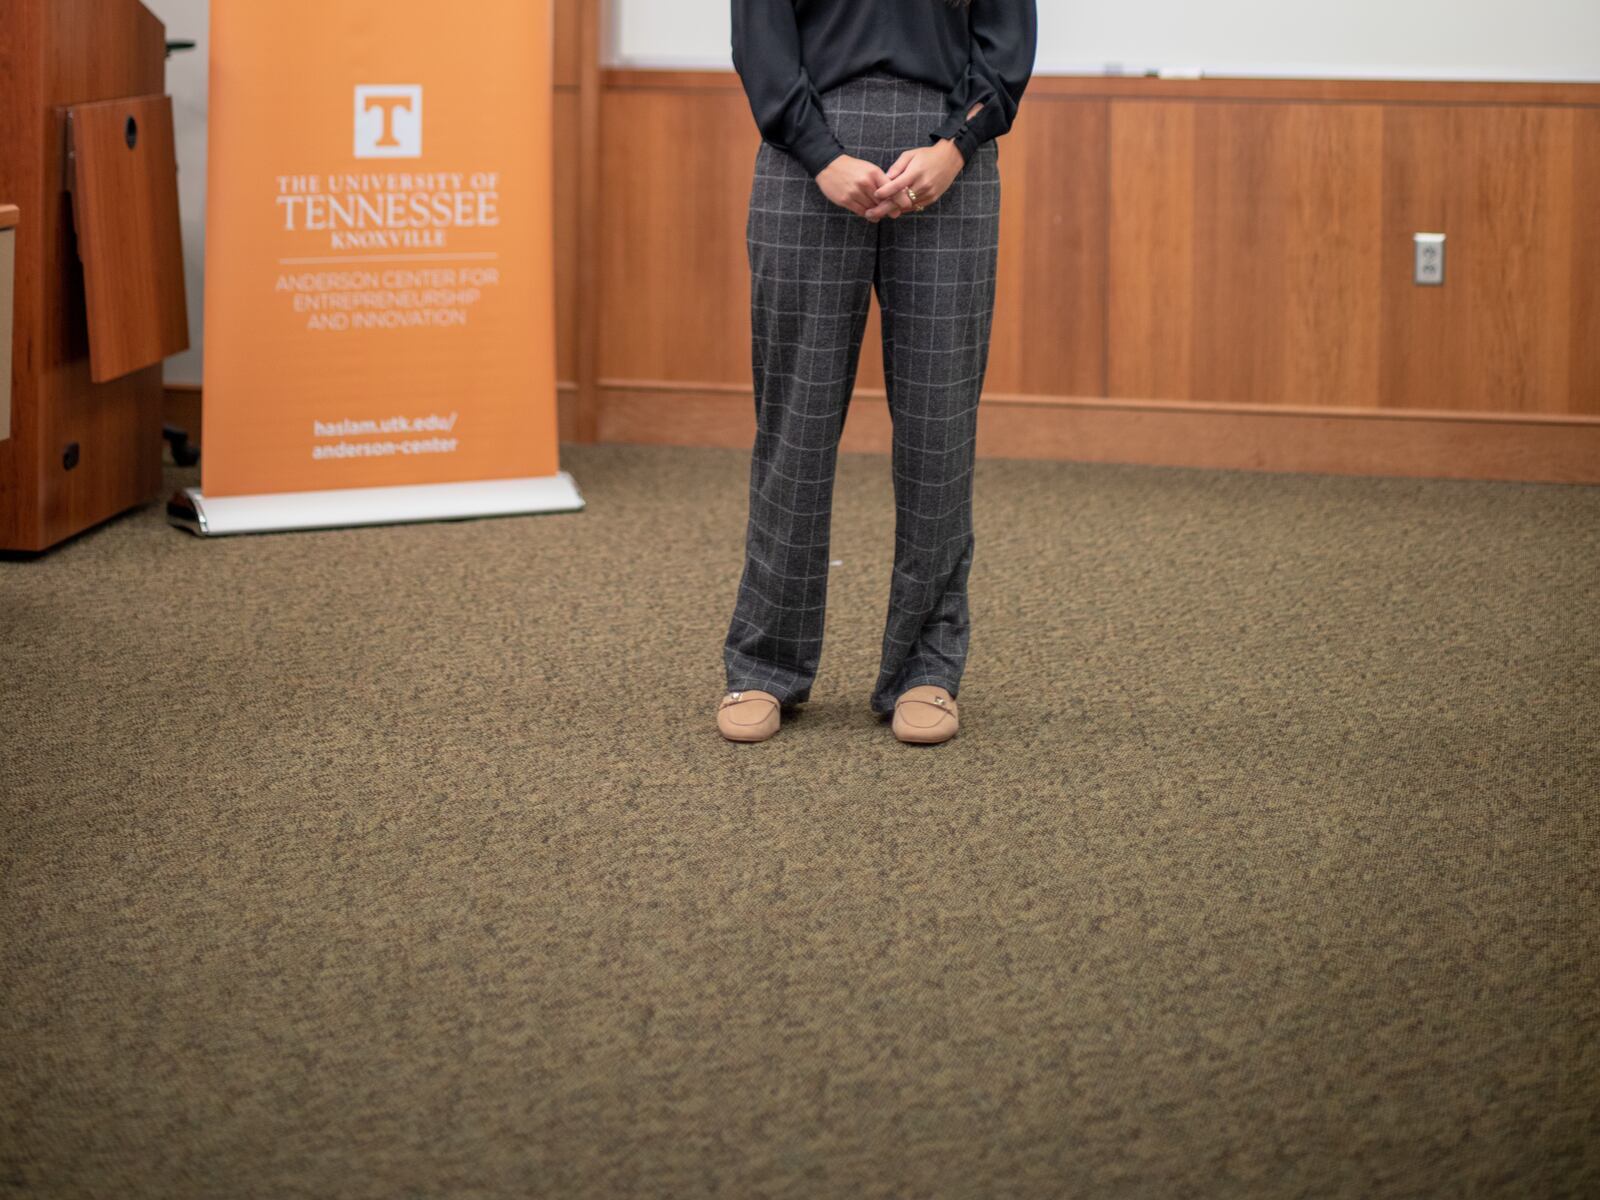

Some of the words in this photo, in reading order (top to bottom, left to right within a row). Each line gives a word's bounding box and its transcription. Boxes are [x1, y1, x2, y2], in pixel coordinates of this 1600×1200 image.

[277, 175, 319, 193] THE
[328, 173, 463, 192] UNIVERSITY
[470, 172, 498, 190] OF
[276, 192, 498, 230] TENNESSEE
[331, 230, 446, 249] KNOXVILLE
[276, 271, 378, 291] ANDERSON
[383, 269, 455, 287] CENTER
[459, 268, 498, 285] FOR
[307, 311, 349, 330] AND
[352, 309, 466, 329] INNOVATION
[314, 412, 458, 437] haslam.utk.edu/
[312, 437, 458, 460] anderson-center
